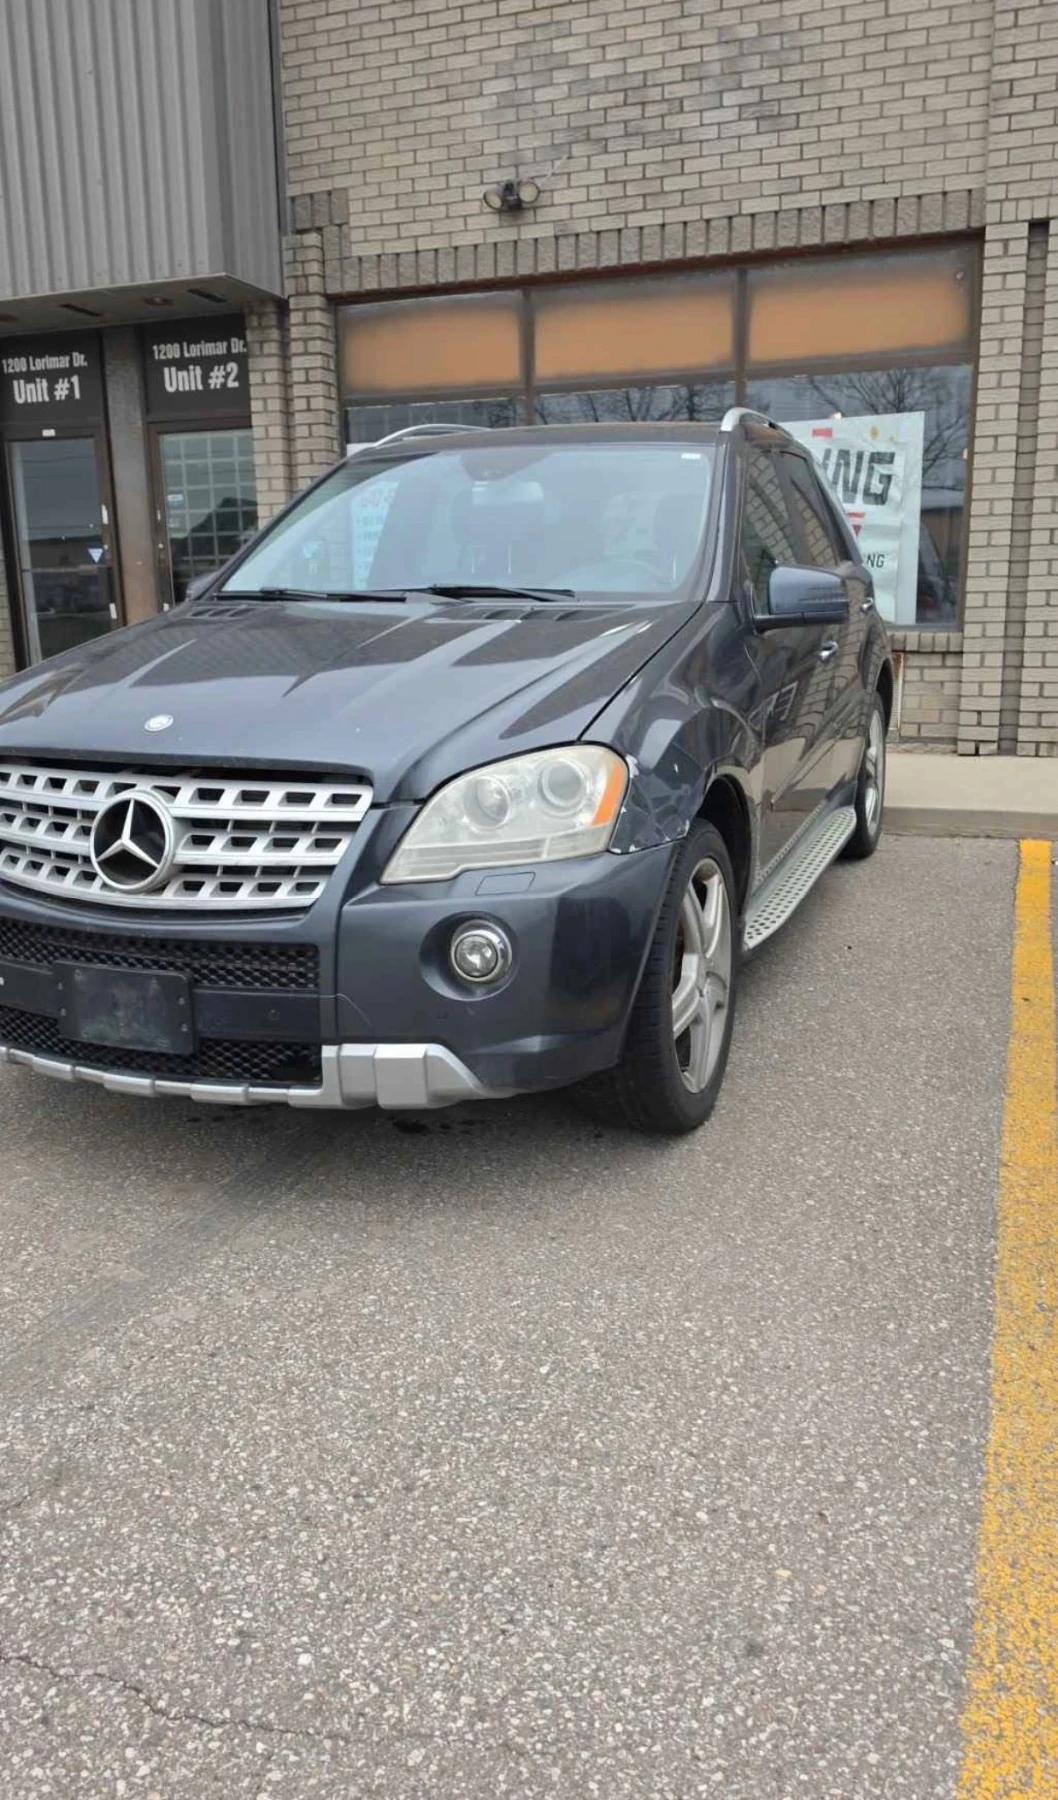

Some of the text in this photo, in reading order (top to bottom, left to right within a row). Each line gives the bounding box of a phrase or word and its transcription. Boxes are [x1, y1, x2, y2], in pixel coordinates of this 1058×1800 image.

[152, 337, 247, 360] 1200 Lorimar Dr.
[2, 351, 88, 374] 1200 Lorimar Dr.
[163, 361, 240, 393] Unit #2
[12, 374, 81, 404] Unit #1
[864, 552, 886, 569] NG
